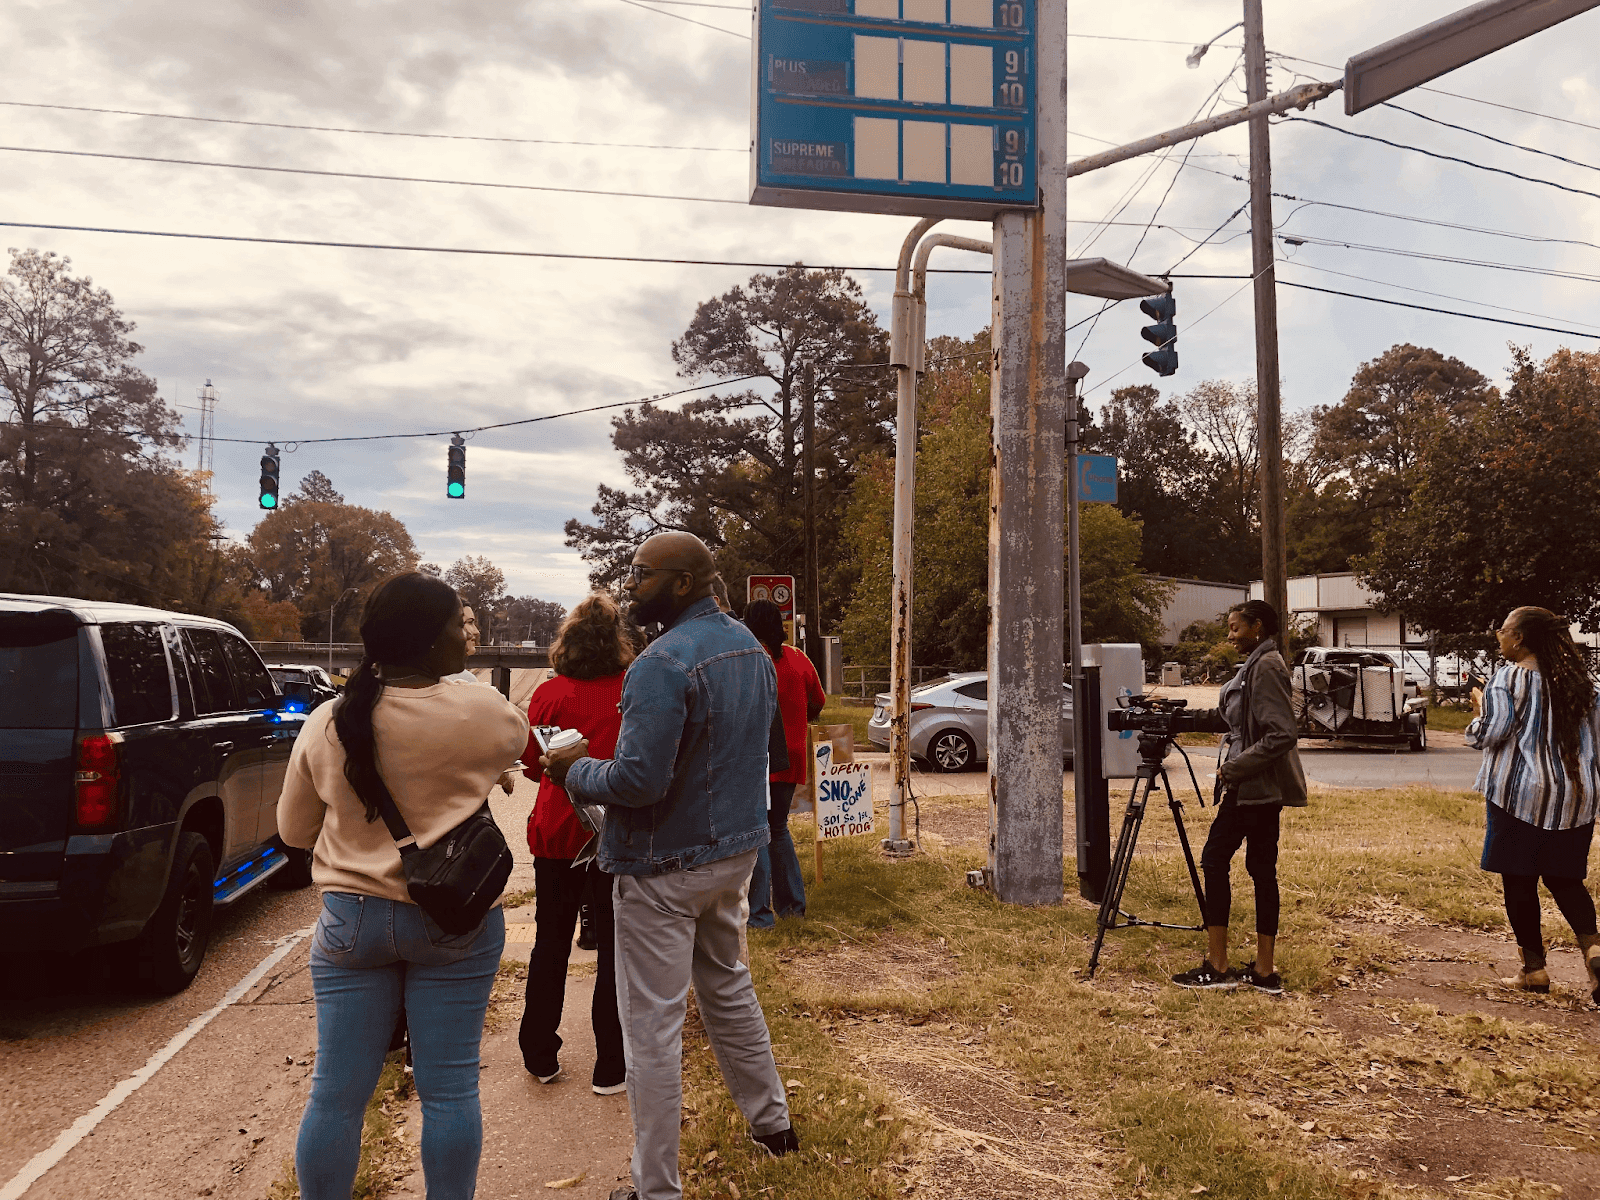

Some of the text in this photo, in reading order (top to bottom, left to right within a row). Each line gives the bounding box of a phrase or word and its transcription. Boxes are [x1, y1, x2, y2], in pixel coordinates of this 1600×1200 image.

[1000, 3, 1023, 27] 10
[1005, 50, 1018, 74] 9
[1000, 83, 1023, 106] 10
[773, 141, 835, 158] SUPREME
[1005, 130, 1019, 153] 9
[1000, 162, 1023, 186] 10
[830, 762, 862, 776] OPEN
[823, 814, 840, 826] 301
